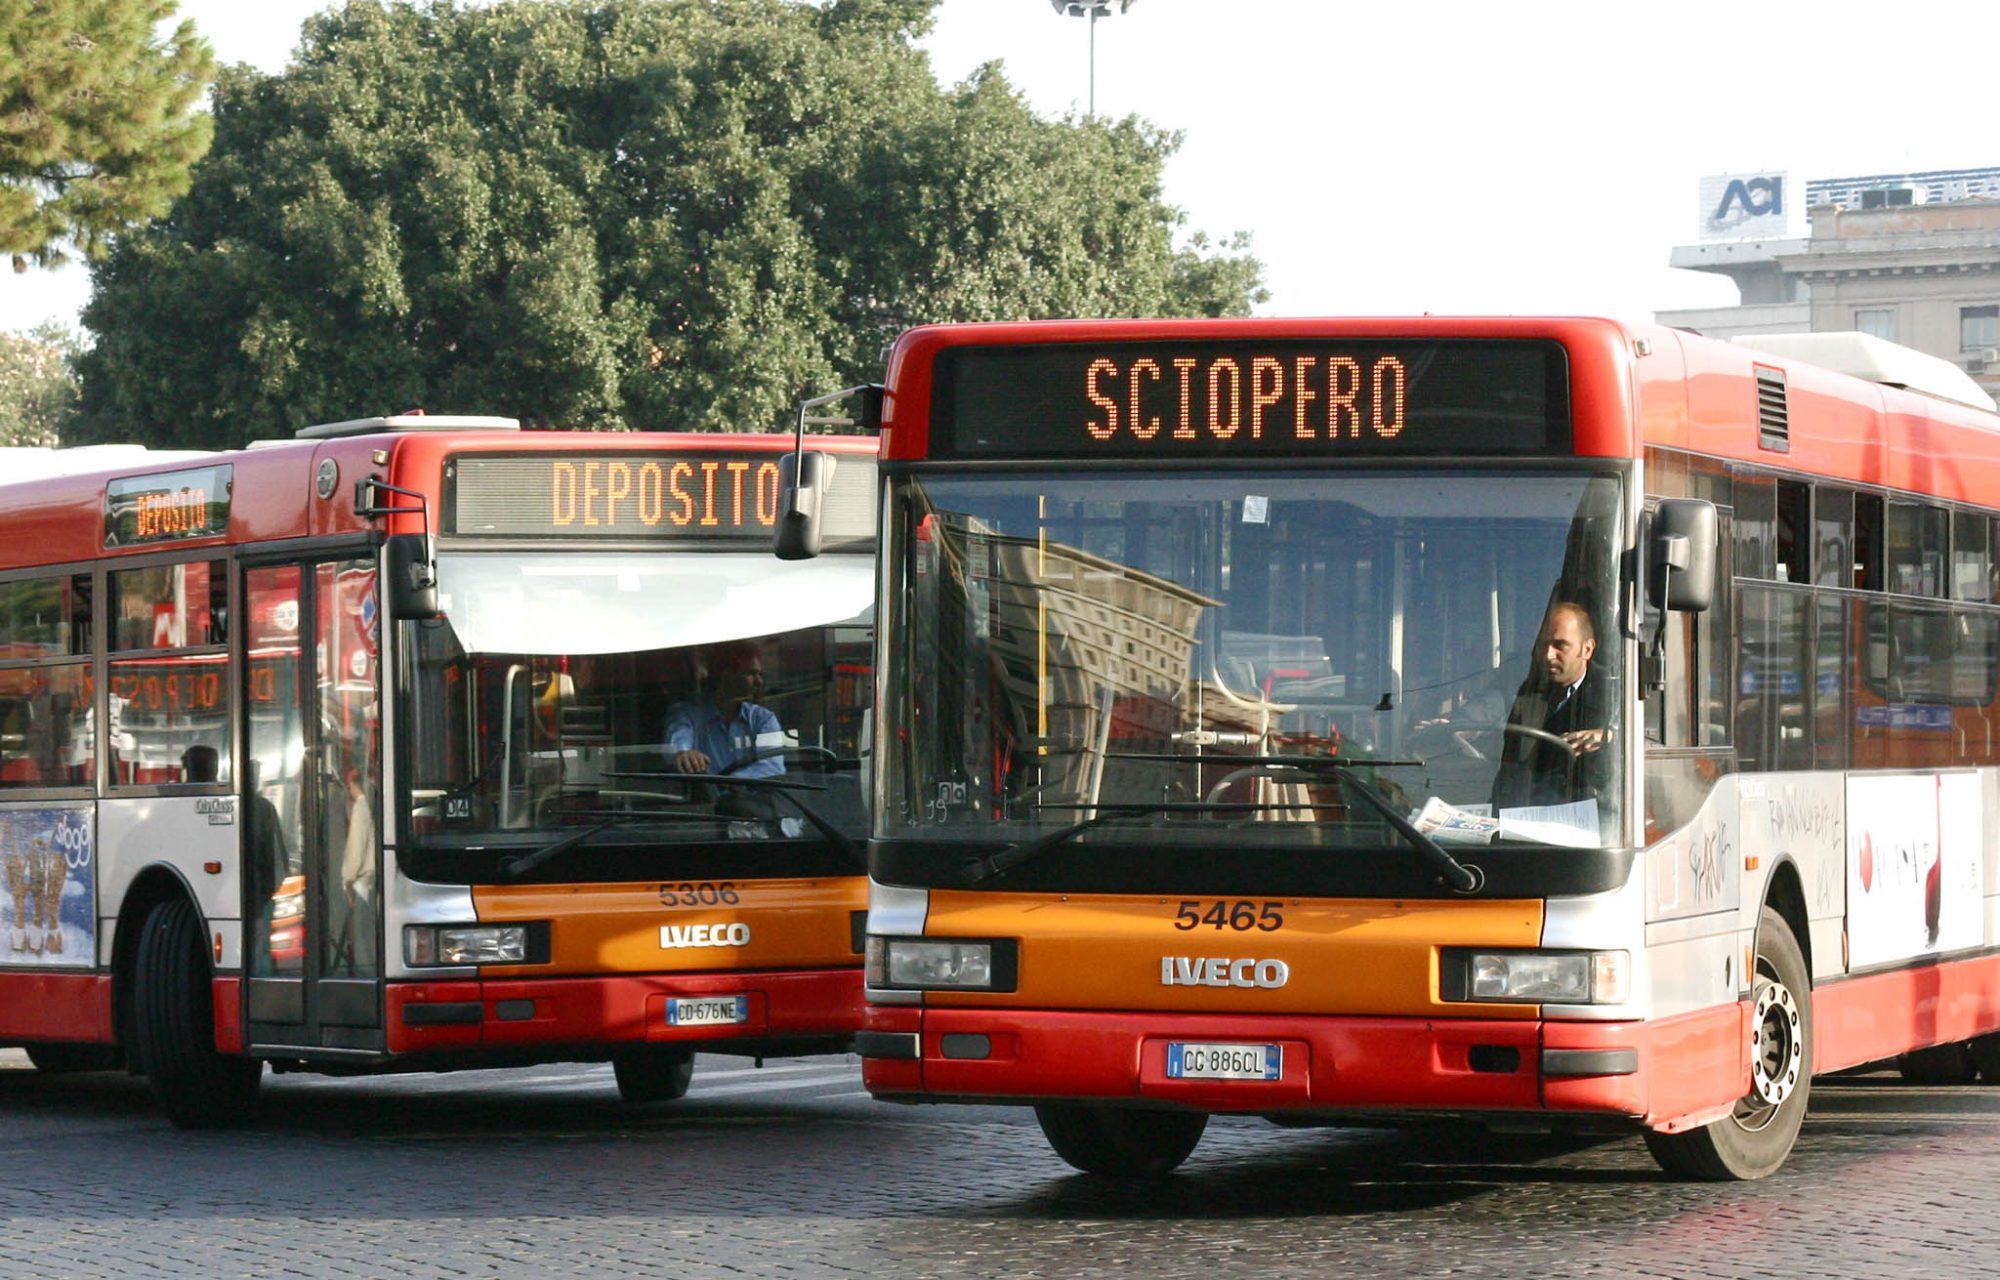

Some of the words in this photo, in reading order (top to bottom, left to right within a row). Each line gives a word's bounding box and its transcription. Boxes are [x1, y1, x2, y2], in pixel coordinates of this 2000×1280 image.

[1715, 176, 1782, 219] ACI
[1087, 356, 1404, 439] SCIOPERO
[137, 489, 206, 536] DEPOSITO
[552, 462, 780, 526] DEPOSITO
[659, 881, 740, 907] 5306
[659, 922, 750, 949] IVECO
[1174, 901, 1284, 932] 5465
[1161, 956, 1290, 989] IVECO
